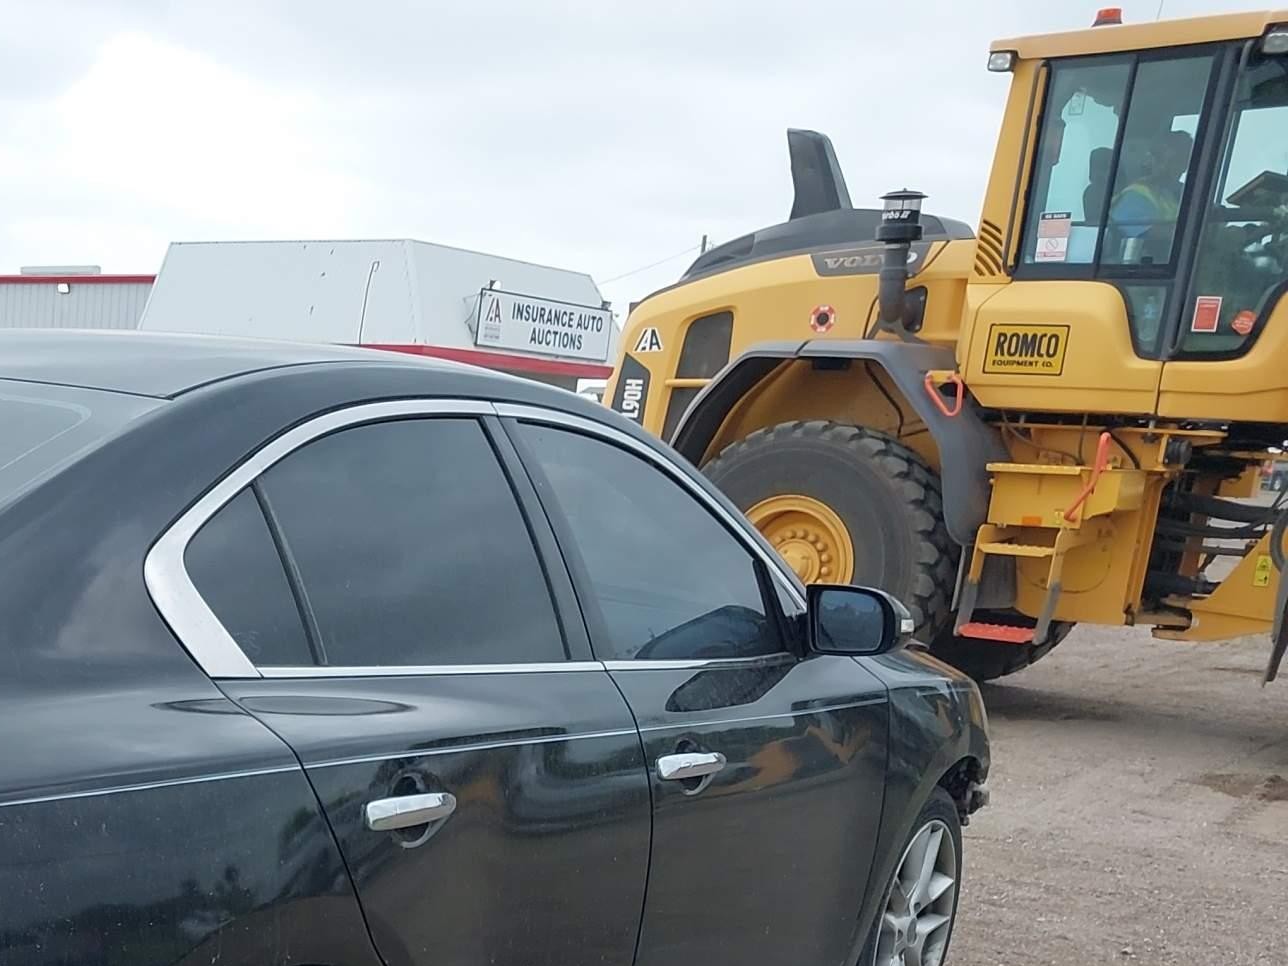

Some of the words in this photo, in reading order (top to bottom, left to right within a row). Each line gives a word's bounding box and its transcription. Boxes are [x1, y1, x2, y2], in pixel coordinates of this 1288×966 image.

[512, 302, 575, 328] INSURANCE
[576, 313, 603, 332] AUTO
[529, 327, 583, 351] AUCTIONS
[994, 332, 1060, 358] ROMCO
[992, 360, 1039, 368] EQUIPMENT
